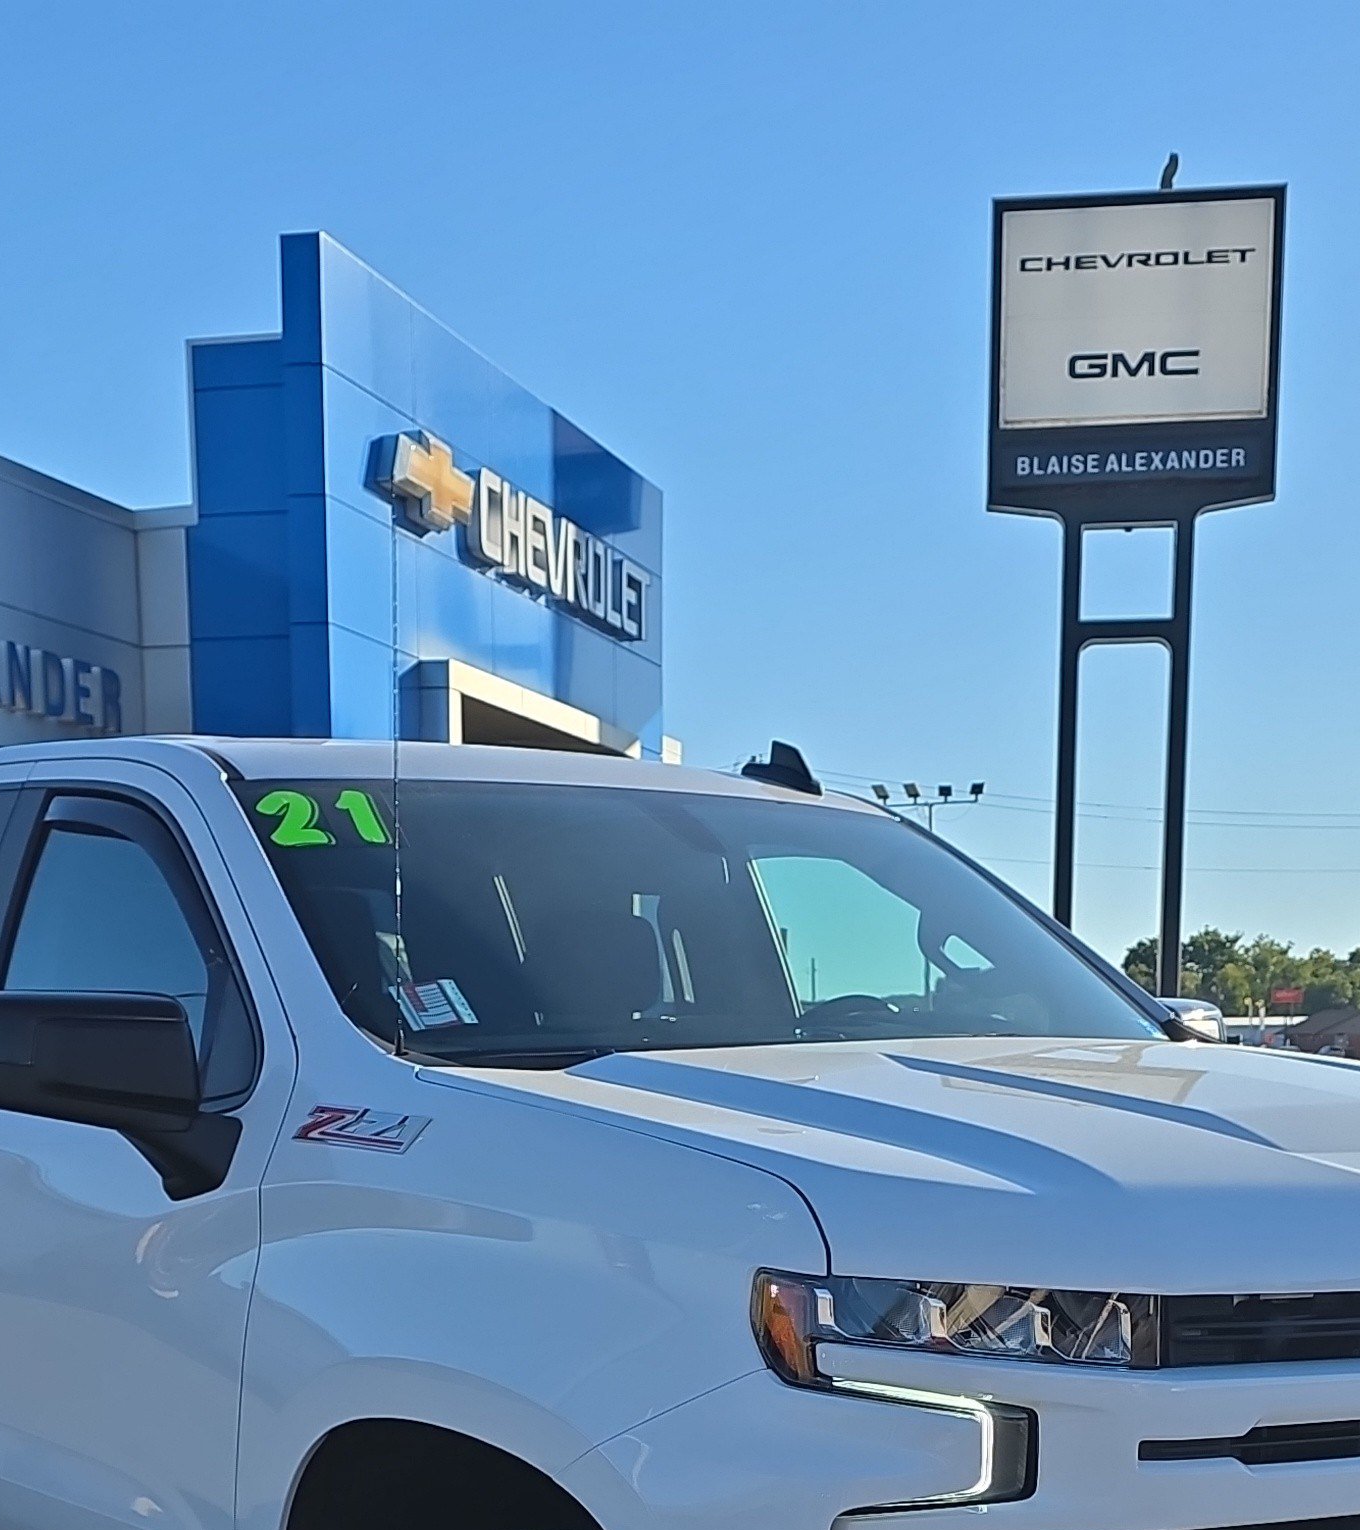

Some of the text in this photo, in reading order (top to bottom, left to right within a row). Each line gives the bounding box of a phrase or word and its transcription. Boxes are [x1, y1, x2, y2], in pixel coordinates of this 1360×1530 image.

[1019, 248, 1256, 272] CHEVROLET
[1068, 350, 1200, 379] GMC
[1016, 449, 1246, 476] BLAISE ALEXANDER
[479, 466, 650, 641] CHEVROLET
[255, 790, 393, 847] 21
